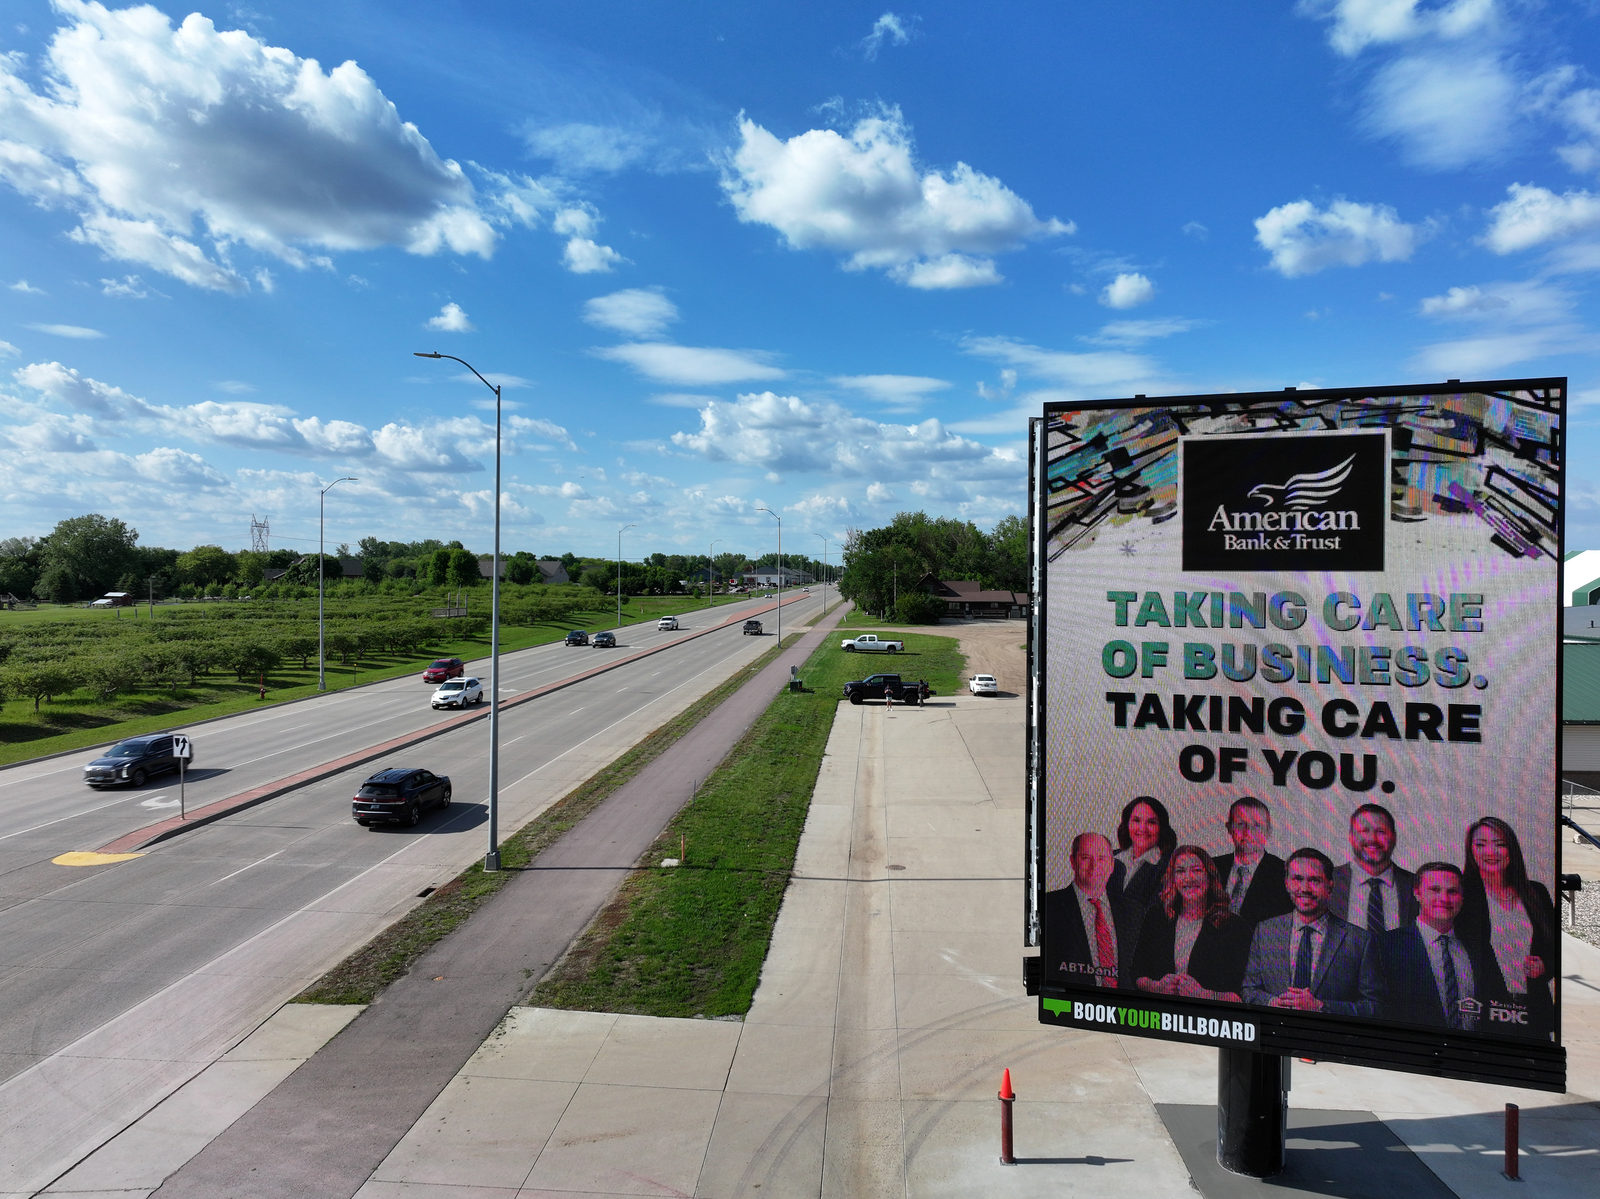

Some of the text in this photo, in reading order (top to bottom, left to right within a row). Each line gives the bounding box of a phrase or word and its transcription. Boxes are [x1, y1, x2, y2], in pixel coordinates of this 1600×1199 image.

[1207, 504, 1361, 531] American
[1224, 533, 1342, 550] Bank & Trust
[1106, 590, 1485, 632] TAKING CARE
[1101, 639, 1489, 690] OF BUSINESS.
[1106, 691, 1483, 743] TAKING CARE
[1178, 744, 1396, 794] OF YOU.
[1059, 961, 1119, 978] ABT.bank
[1490, 1007, 1529, 1025] FDIC
